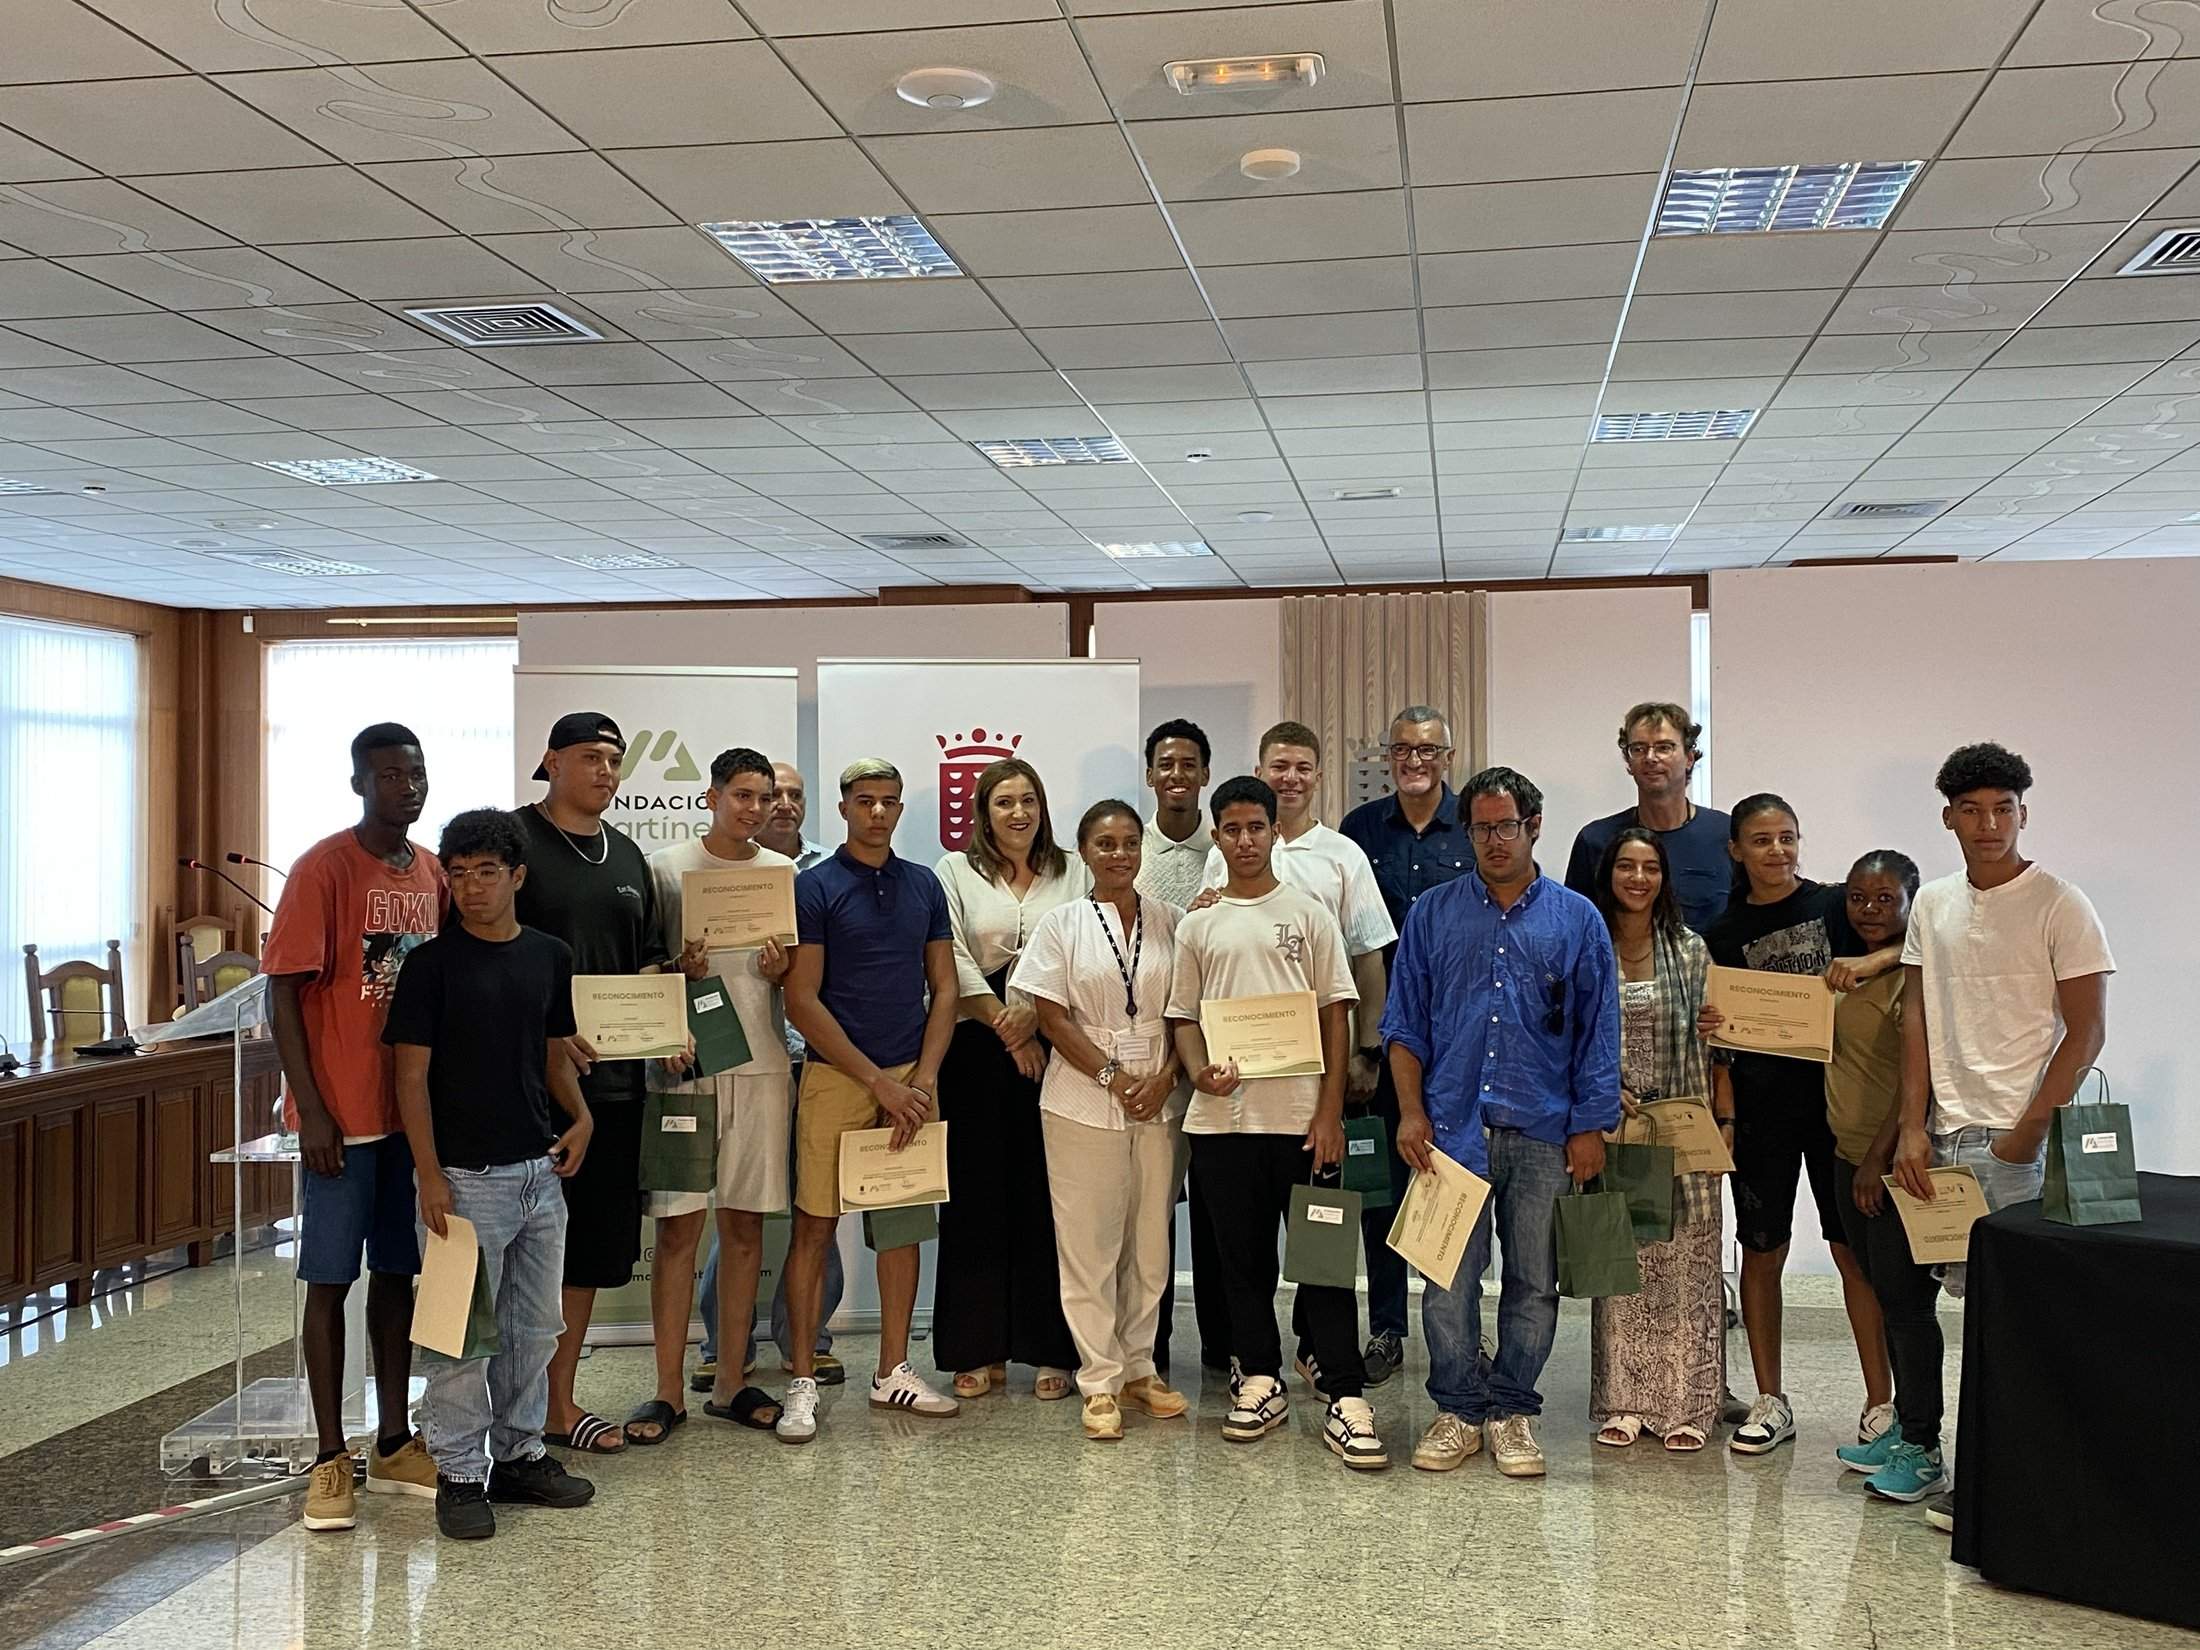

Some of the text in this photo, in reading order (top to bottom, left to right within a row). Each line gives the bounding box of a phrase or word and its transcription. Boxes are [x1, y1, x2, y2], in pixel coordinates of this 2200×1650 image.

[614, 791, 709, 810] NDACIÓ
[614, 815, 711, 840] artíne
[702, 882, 774, 894] RECONOCIMIENTO
[364, 889, 439, 934] GOKU
[592, 991, 665, 1001] RECONOCIMIENTO
[1730, 984, 1811, 1000] RECONOCIMIENTO
[1222, 1009, 1297, 1023] RECONOCIMIENTO
[1436, 1192, 1468, 1261] RECONOCIMIENTO
